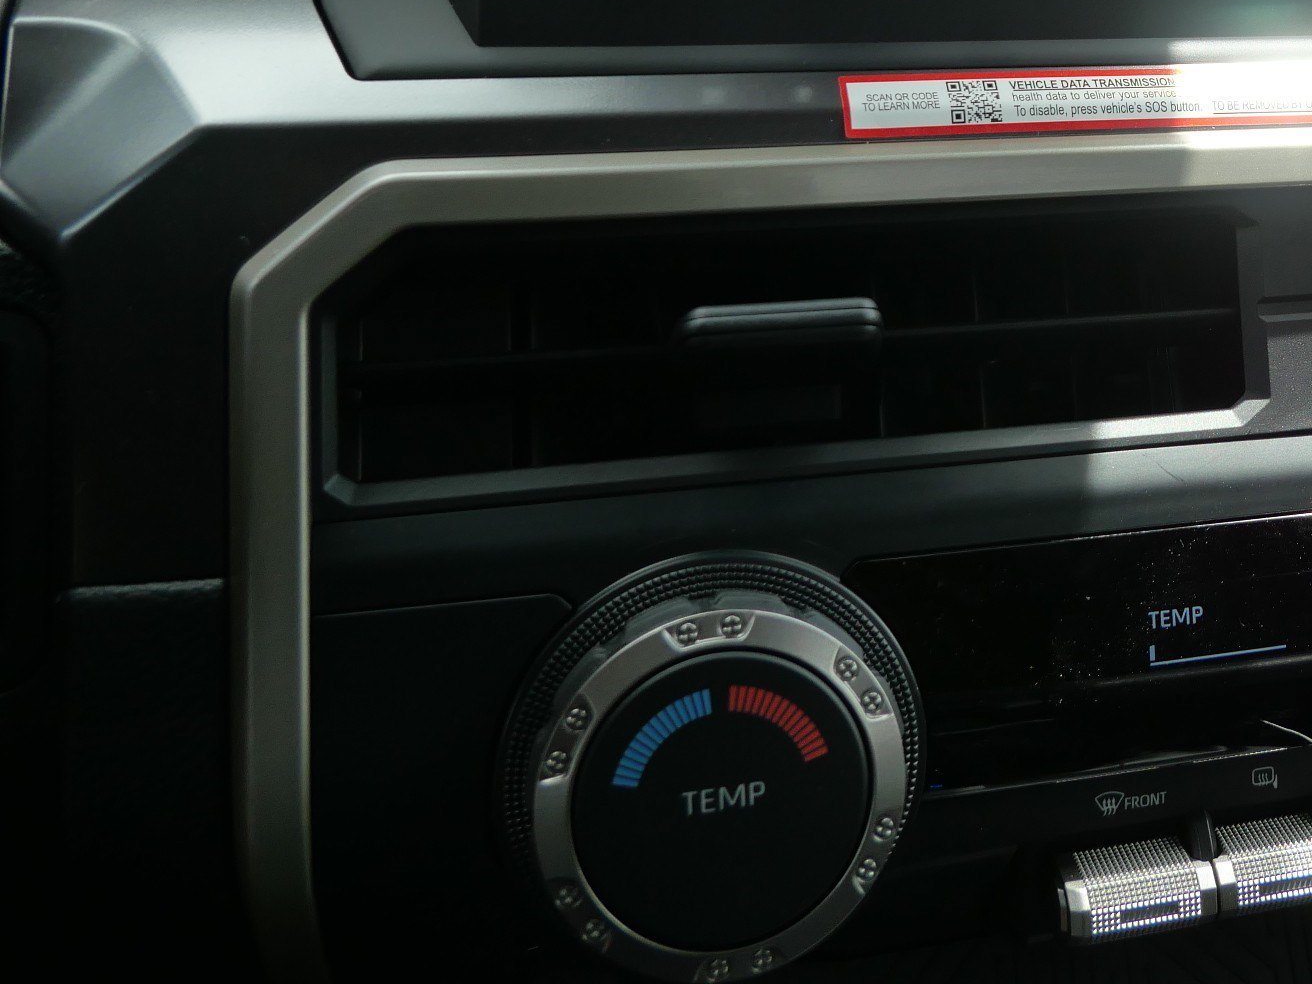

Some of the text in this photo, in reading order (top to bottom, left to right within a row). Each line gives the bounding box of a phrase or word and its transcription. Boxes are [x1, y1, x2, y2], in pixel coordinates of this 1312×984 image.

[1008, 77, 1176, 91] VEHICLE DATA TRANSMISSION
[865, 91, 940, 102] SCAN QR CODE
[1012, 92, 1043, 102] health
[1045, 91, 1068, 101] data
[1070, 91, 1081, 101] to
[1083, 90, 1116, 100] deliver
[1118, 90, 1140, 102] your
[862, 100, 941, 112] TO LEARN MORE
[1013, 105, 1027, 118] To
[1029, 103, 1068, 118] disable,
[1070, 105, 1098, 118] press
[1100, 101, 1143, 115] vehicle's
[1145, 101, 1168, 113] SOS
[1212, 100, 1225, 112] TO
[1227, 100, 1240, 111] BE
[1242, 99, 1289, 111] REMOVED
[1291, 99, 1303, 109] BY
[1148, 604, 1205, 630] TEMP
[681, 779, 767, 816] TEMP
[1124, 790, 1168, 809] FRONT
